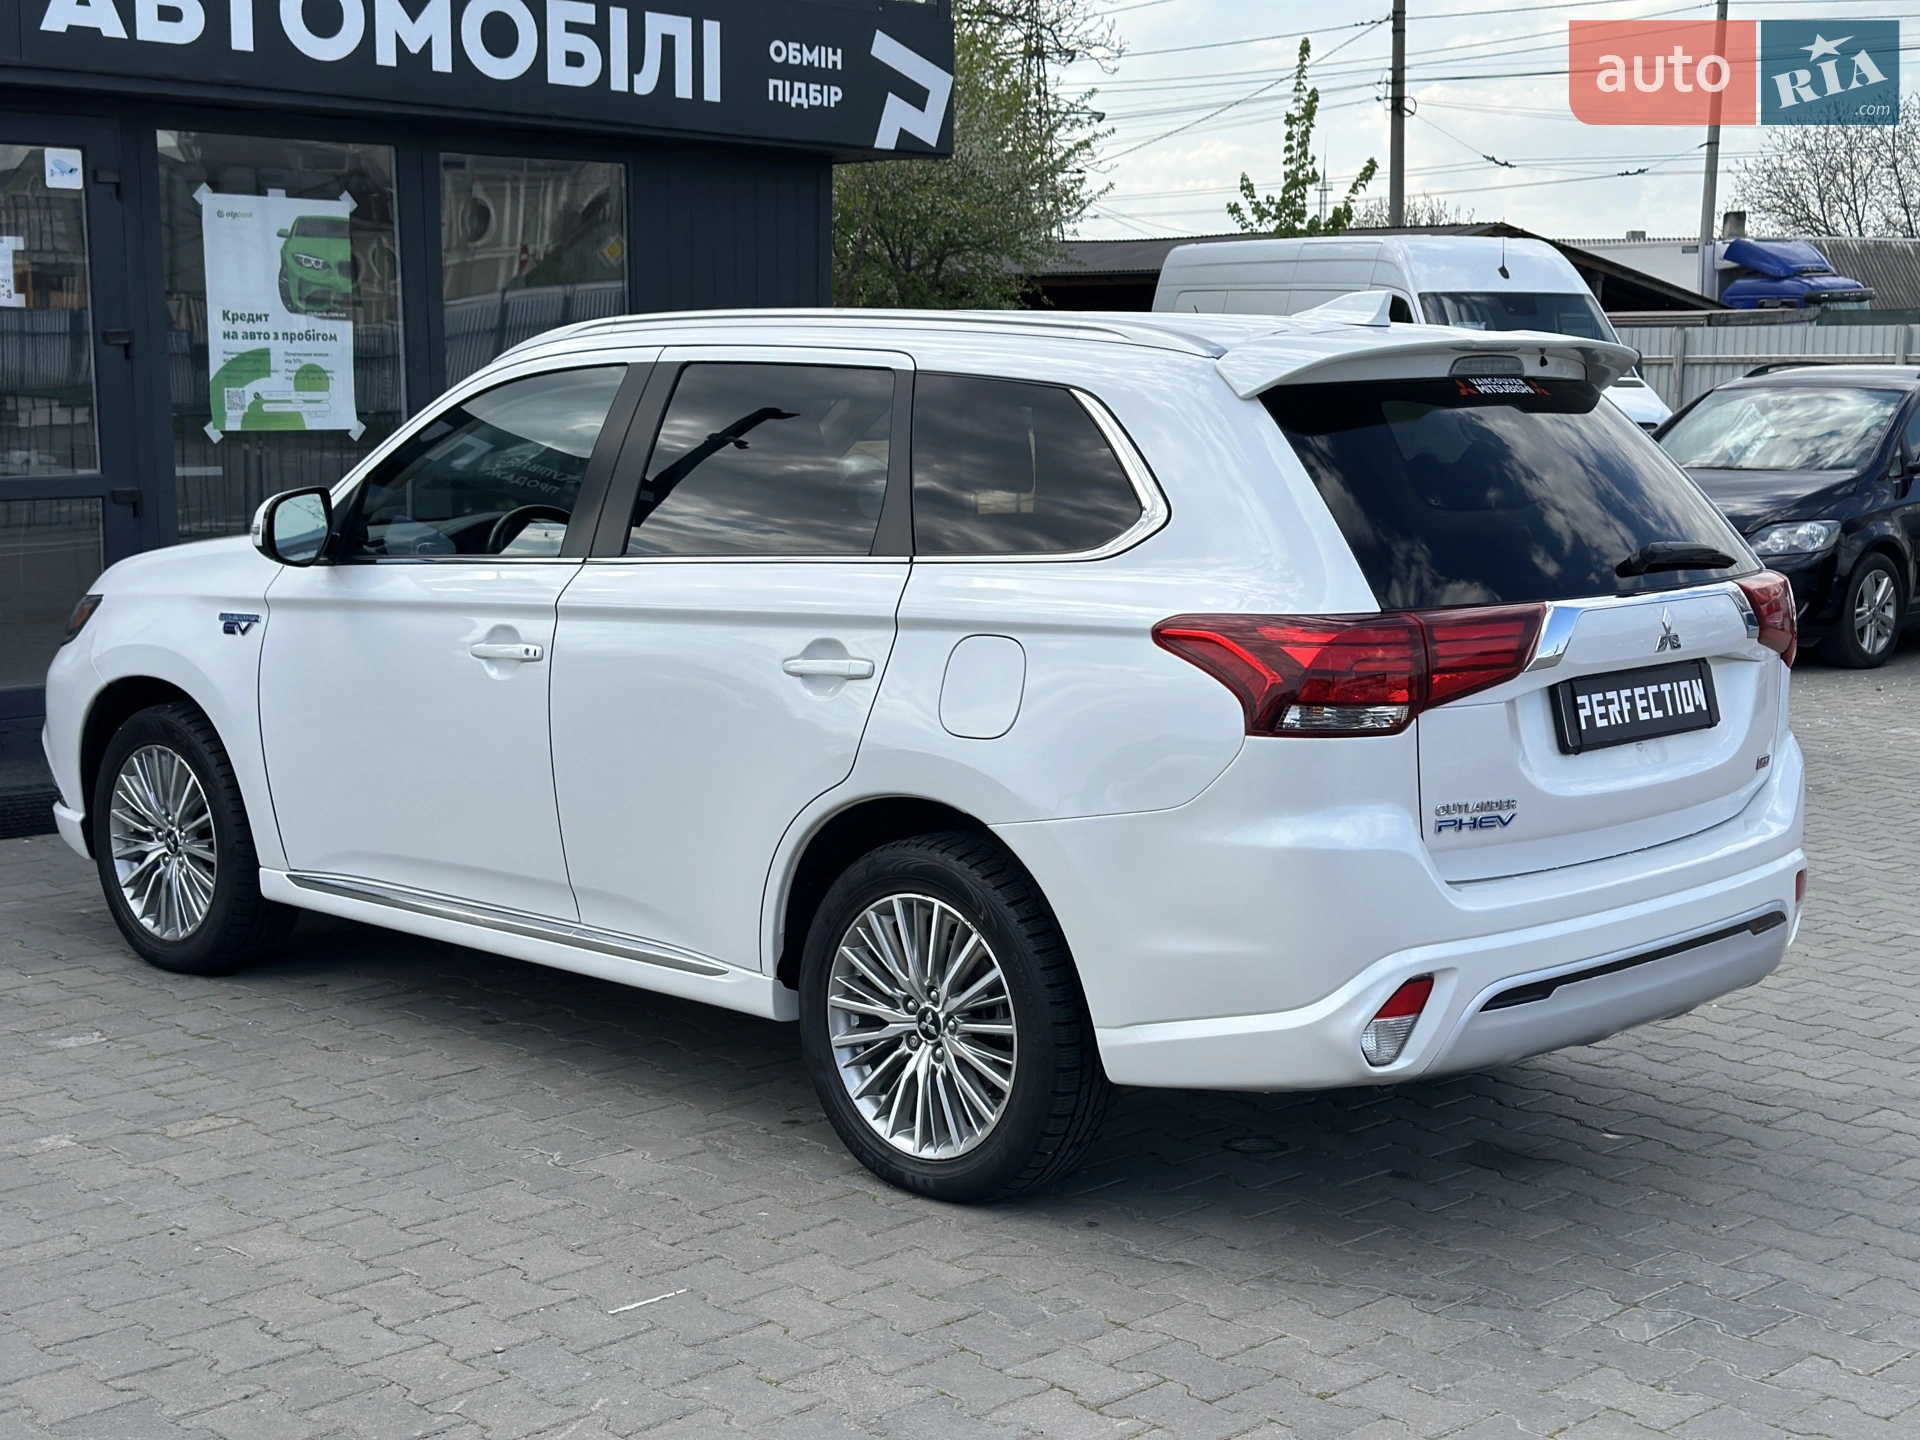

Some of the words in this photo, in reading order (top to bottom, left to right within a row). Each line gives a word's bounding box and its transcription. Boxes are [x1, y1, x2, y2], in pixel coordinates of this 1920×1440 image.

[769, 40, 843, 71] ОБМІН
[768, 78, 843, 108] ПІДБІР
[222, 309, 270, 325] Кредит
[223, 330, 240, 341] на
[242, 331, 271, 341] авто
[273, 332, 279, 342] з
[282, 329, 338, 344] пробігом
[1468, 377, 1526, 386] VANCOUVER
[1475, 384, 1535, 394] MITSUBISHI
[223, 621, 255, 636] EV
[1576, 678, 1707, 731] PERFECTION
[1435, 797, 1518, 816] OUTLANDER
[1434, 811, 1518, 835] PHEV
